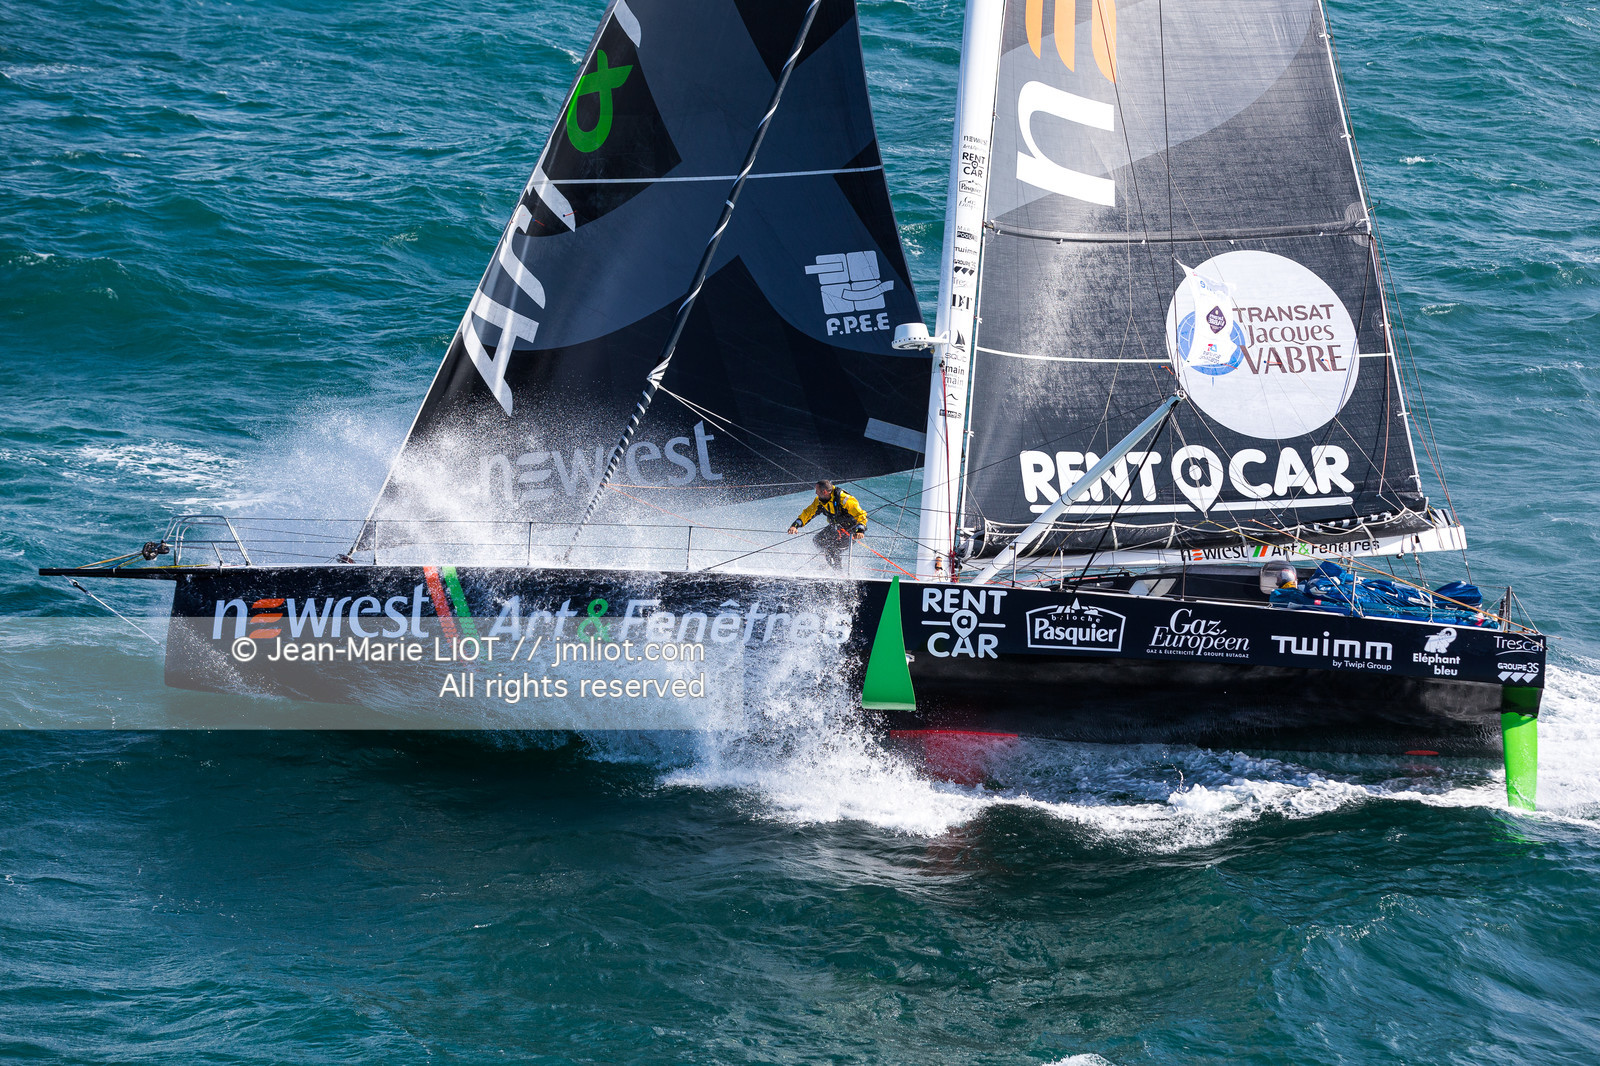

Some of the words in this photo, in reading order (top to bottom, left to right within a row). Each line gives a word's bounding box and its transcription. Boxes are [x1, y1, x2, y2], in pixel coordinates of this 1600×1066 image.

[962, 152, 986, 165] RENT
[963, 166, 983, 178] CAR
[1232, 304, 1334, 323] TRANSAT
[1247, 325, 1335, 349] Jacques
[1239, 345, 1347, 375] VABRE
[1019, 450, 1162, 503] RENT
[1228, 445, 1355, 498] CAR
[922, 587, 1008, 615] RENT
[619, 599, 853, 644] Fenêtres
[1034, 617, 1117, 645] Pasquier
[1170, 608, 1222, 636] Gaz
[927, 631, 999, 659] CAR
[1149, 626, 1250, 656] Européen
[1493, 635, 1544, 652] Trescal
[1332, 659, 1343, 669] by
[1344, 660, 1366, 670] Twipi
[1366, 661, 1393, 672] Group
[1412, 652, 1461, 666] Eléphant
[1433, 665, 1459, 676] bleu
